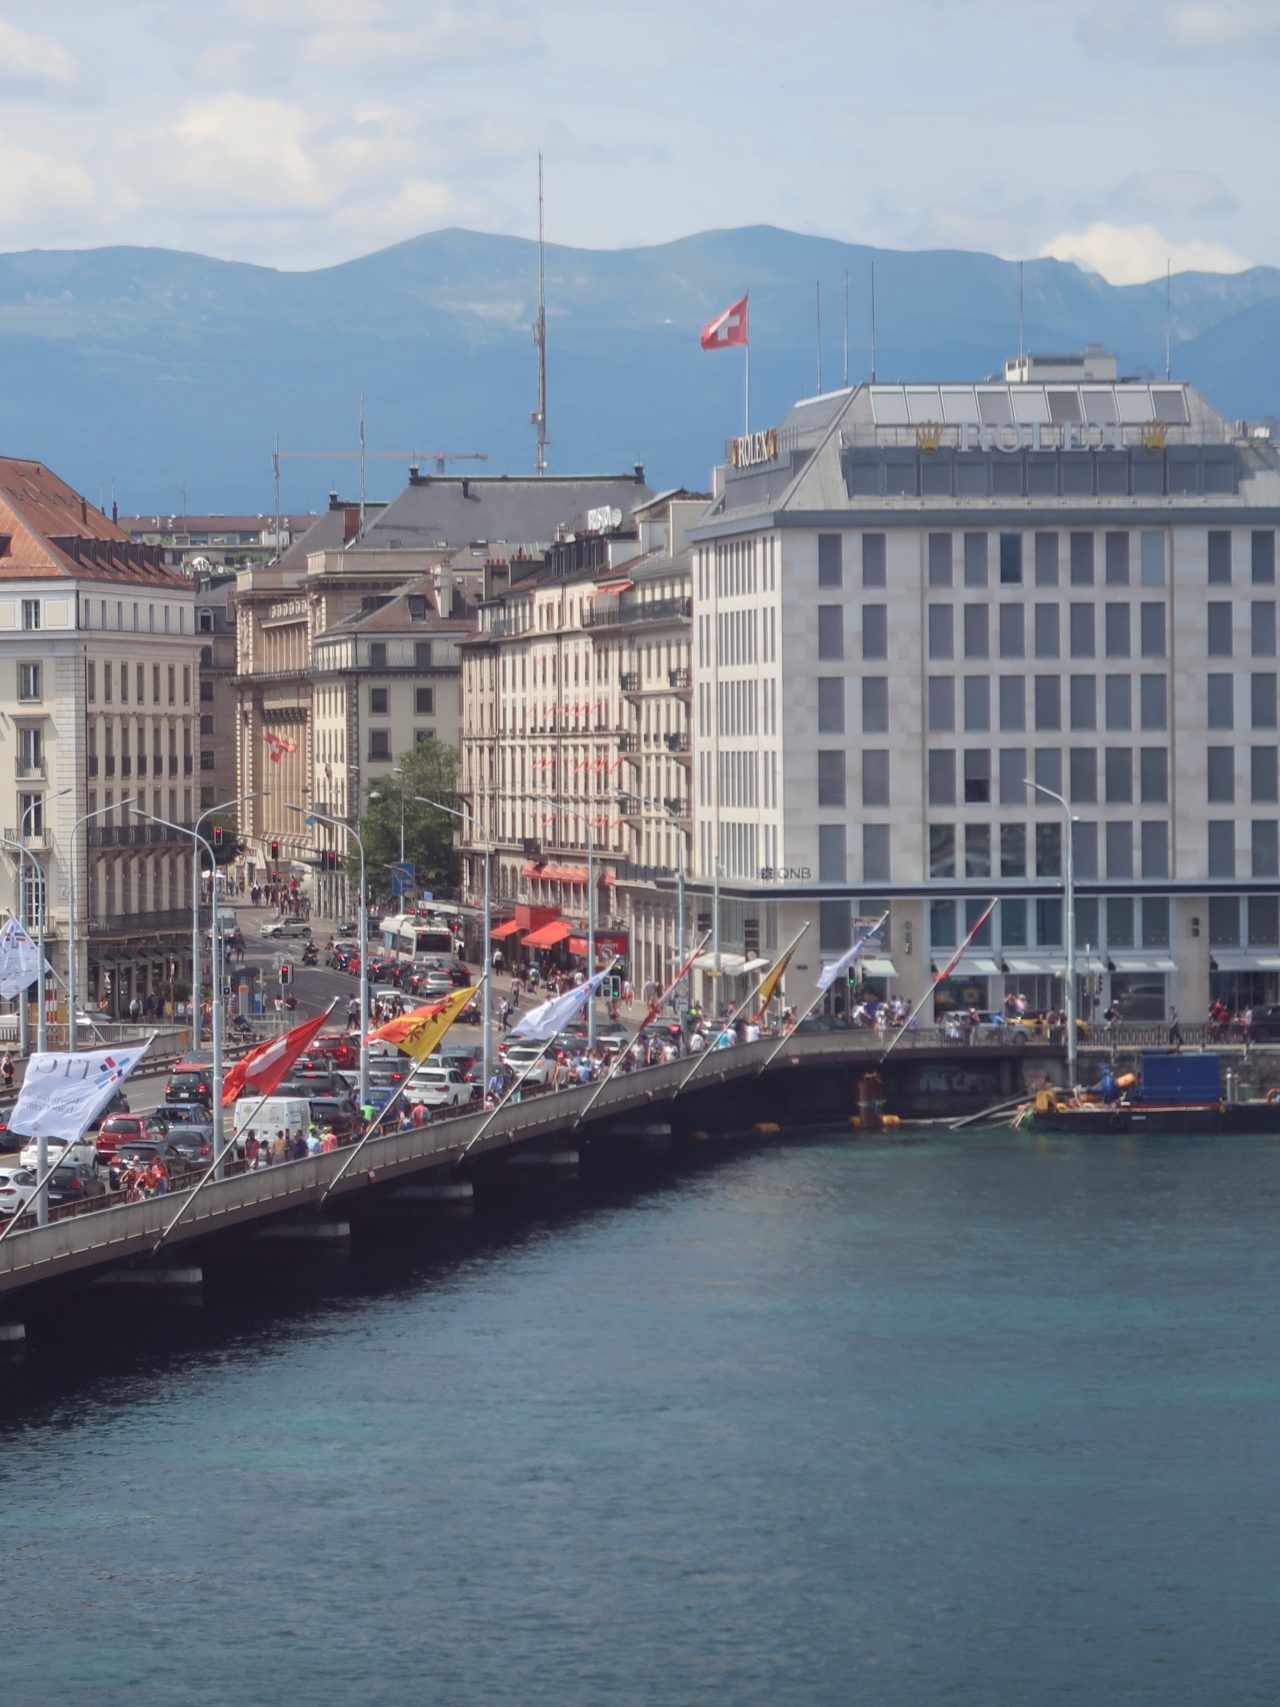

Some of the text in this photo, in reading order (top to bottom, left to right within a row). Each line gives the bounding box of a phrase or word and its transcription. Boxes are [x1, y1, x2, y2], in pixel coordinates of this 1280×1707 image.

[738, 430, 768, 467] ROLEX
[956, 421, 1130, 453] ROLEX
[778, 866, 812, 880] QNB
